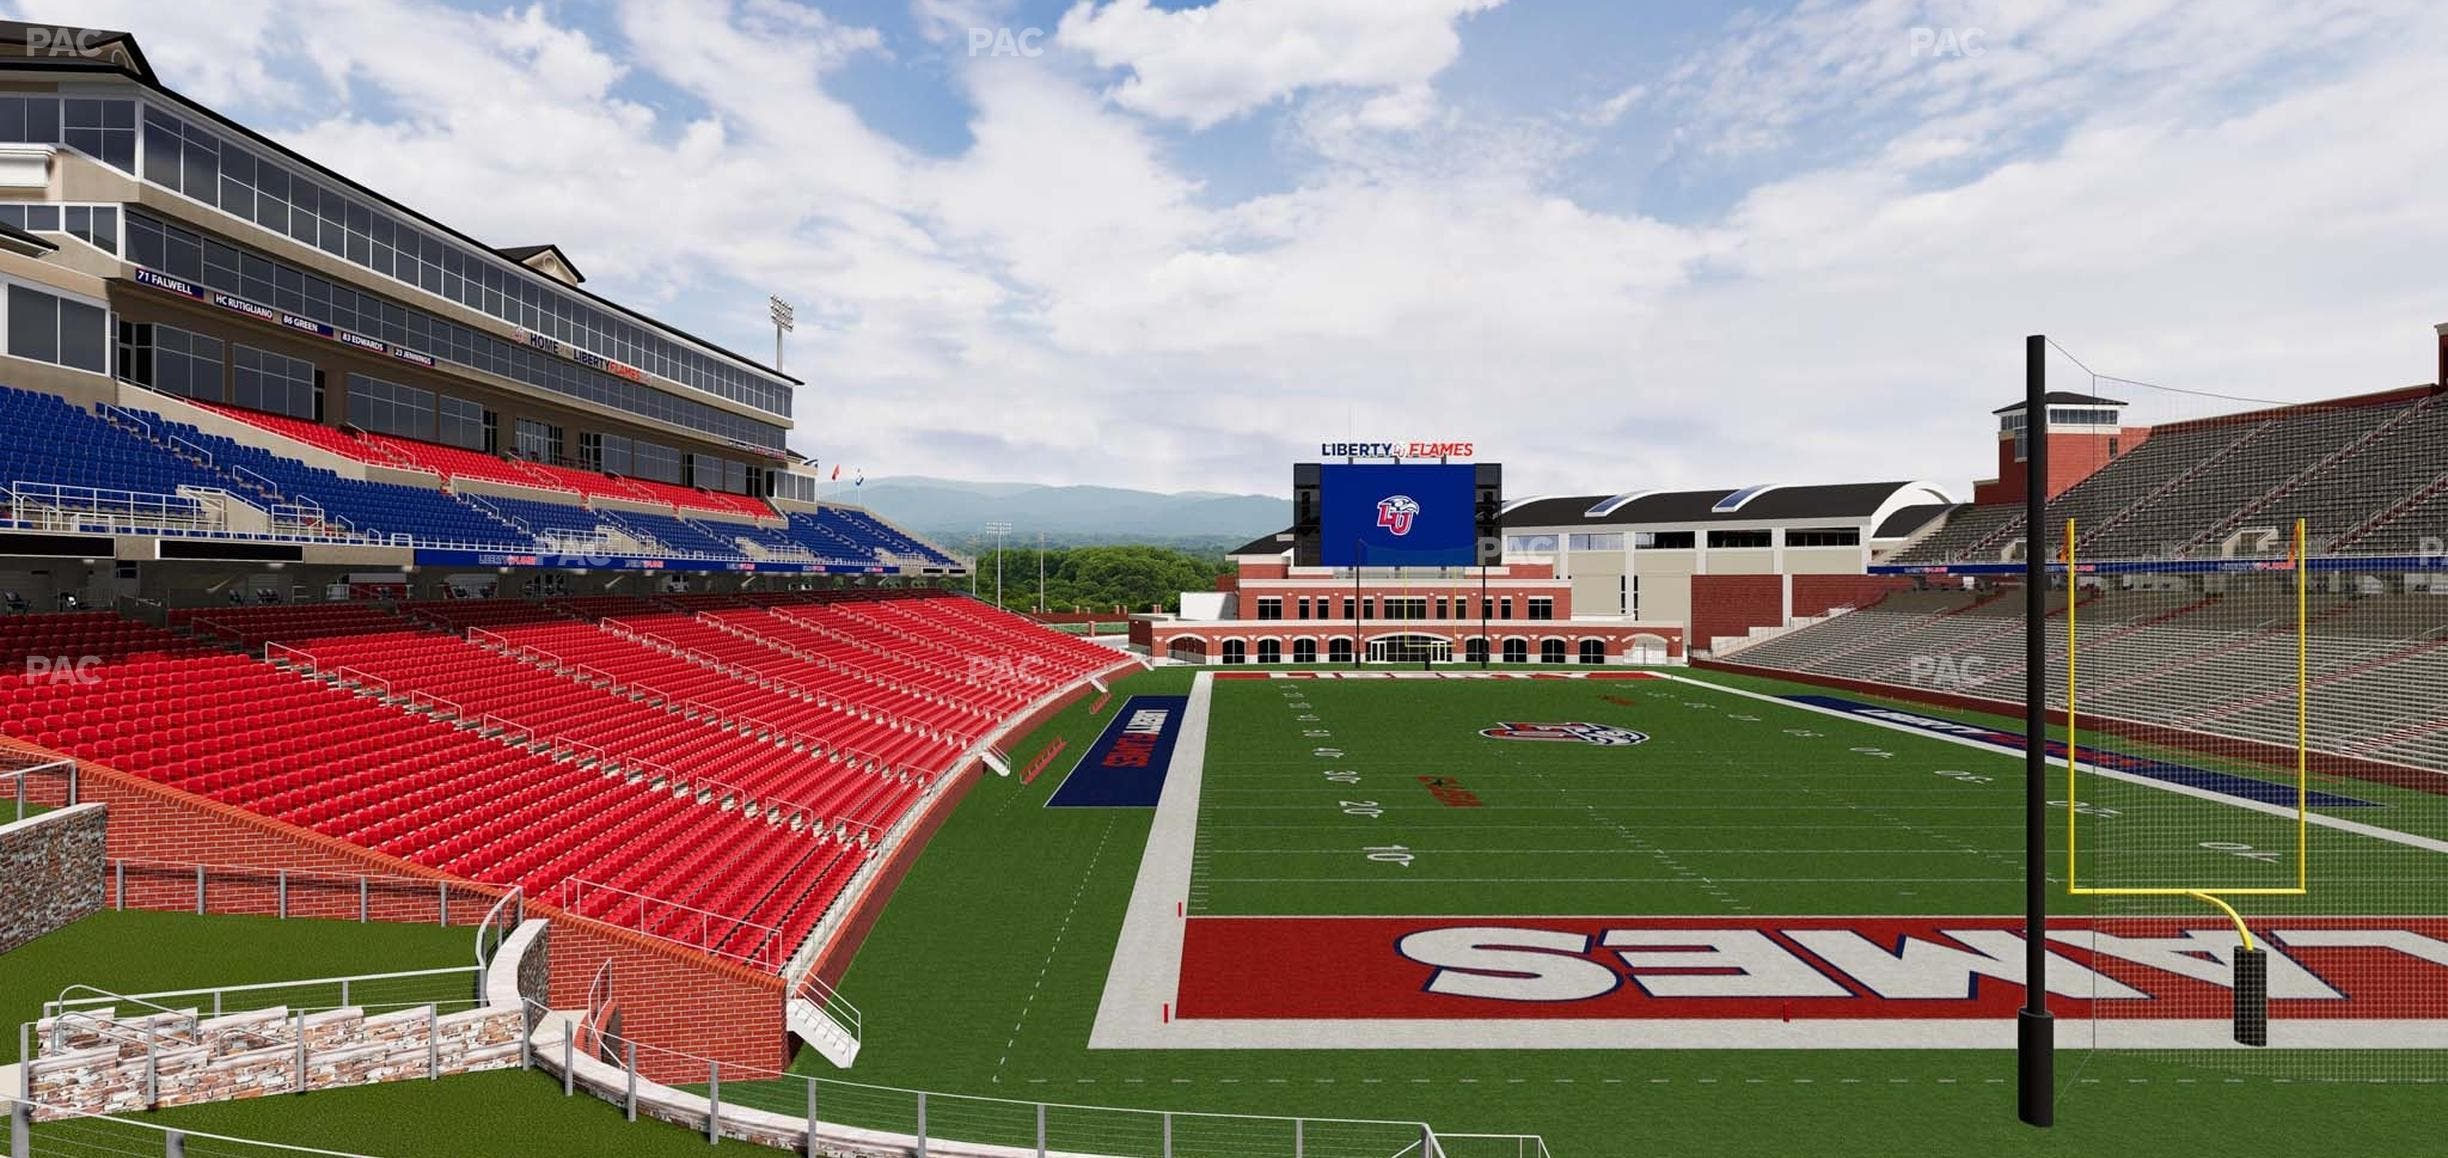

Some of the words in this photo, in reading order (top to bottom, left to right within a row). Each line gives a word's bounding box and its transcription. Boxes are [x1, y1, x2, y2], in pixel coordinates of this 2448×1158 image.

[137, 270, 149, 281] 71
[152, 274, 192, 295] FALWELL
[215, 294, 227, 306] HC
[228, 298, 273, 319] RUTIGLIANO
[293, 317, 319, 332] GREEN
[351, 335, 384, 351] EDWARDS
[530, 332, 560, 354] HOME
[1322, 443, 1393, 456] LIBERTY
[1409, 443, 1473, 457] FLAMES
